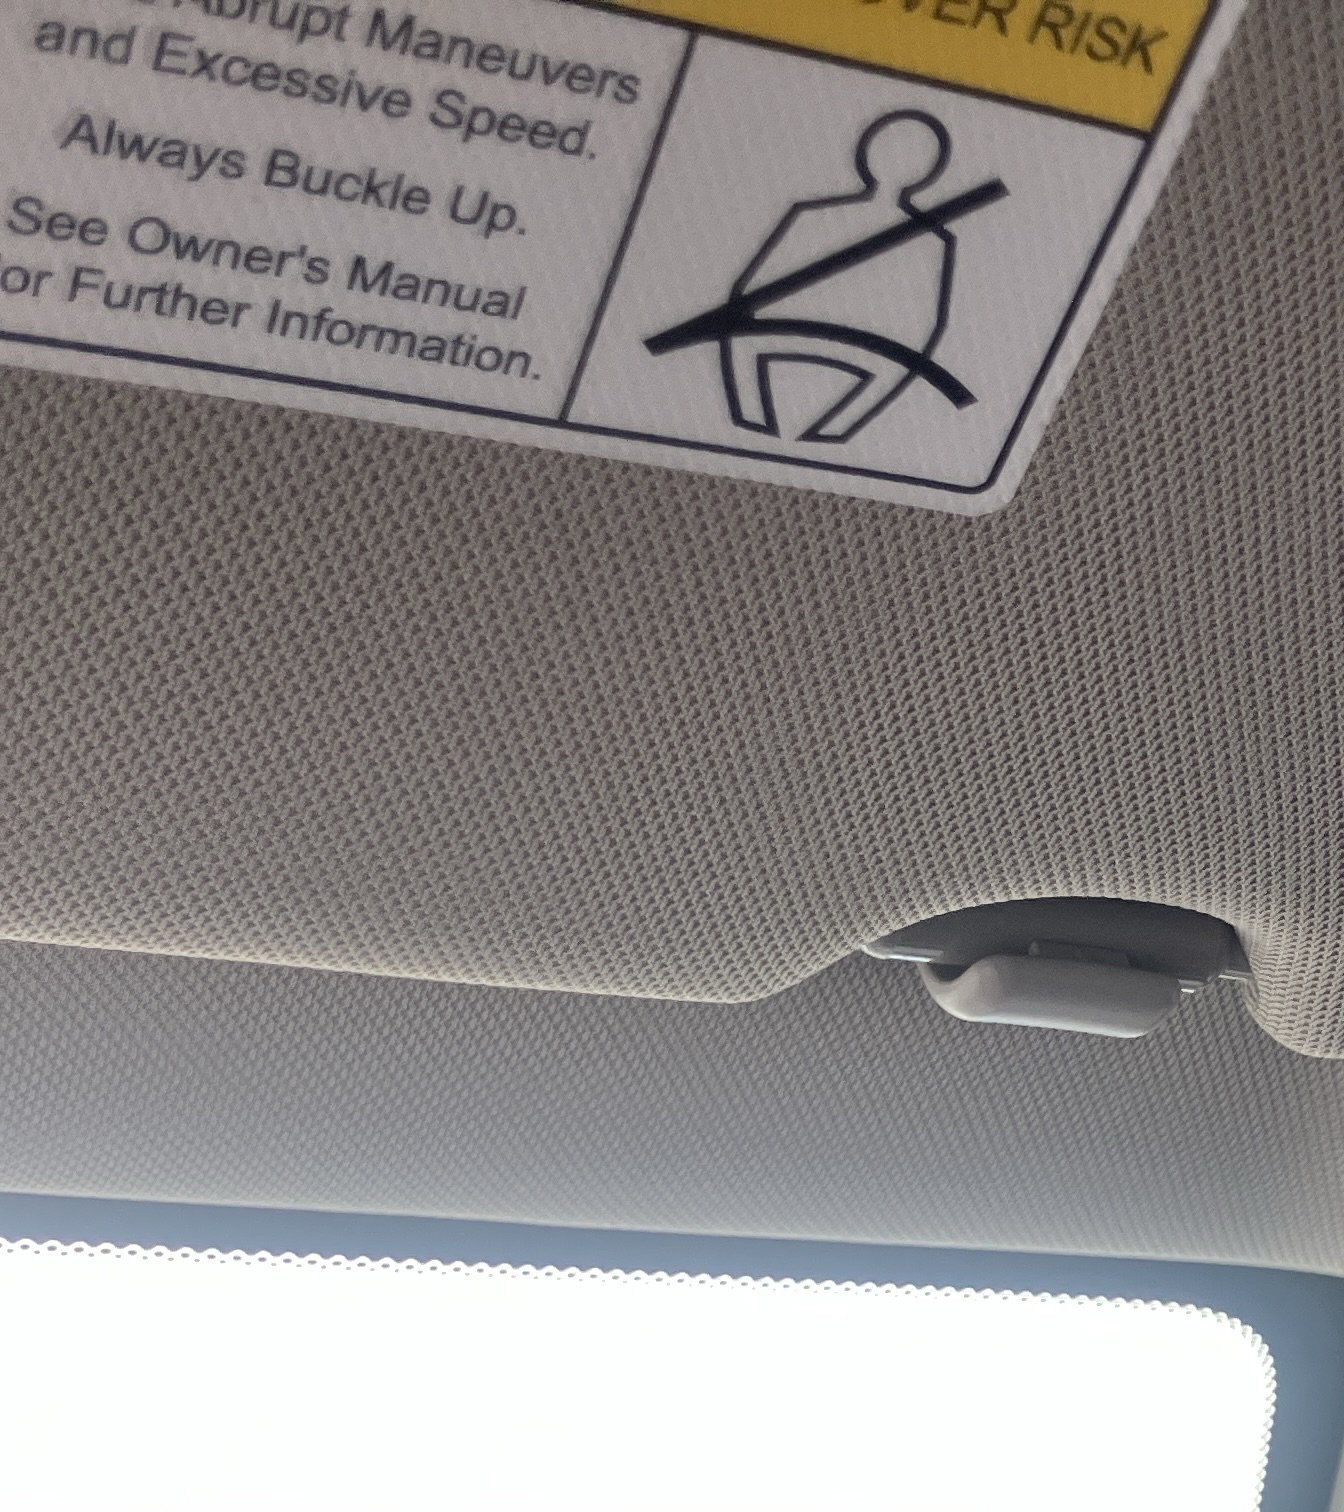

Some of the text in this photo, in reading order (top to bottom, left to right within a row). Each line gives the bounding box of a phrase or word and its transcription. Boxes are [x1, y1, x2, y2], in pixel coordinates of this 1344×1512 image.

[34, 20, 598, 161] and Excessive Speed.
[173, 0, 642, 105] brupt Maneuvers
[1028, 0, 1170, 76] RISK
[60, 113, 528, 240] Always Buckle Up.
[7, 195, 528, 321] See Owner's Manual
[0, 265, 542, 381] or Further Information.
